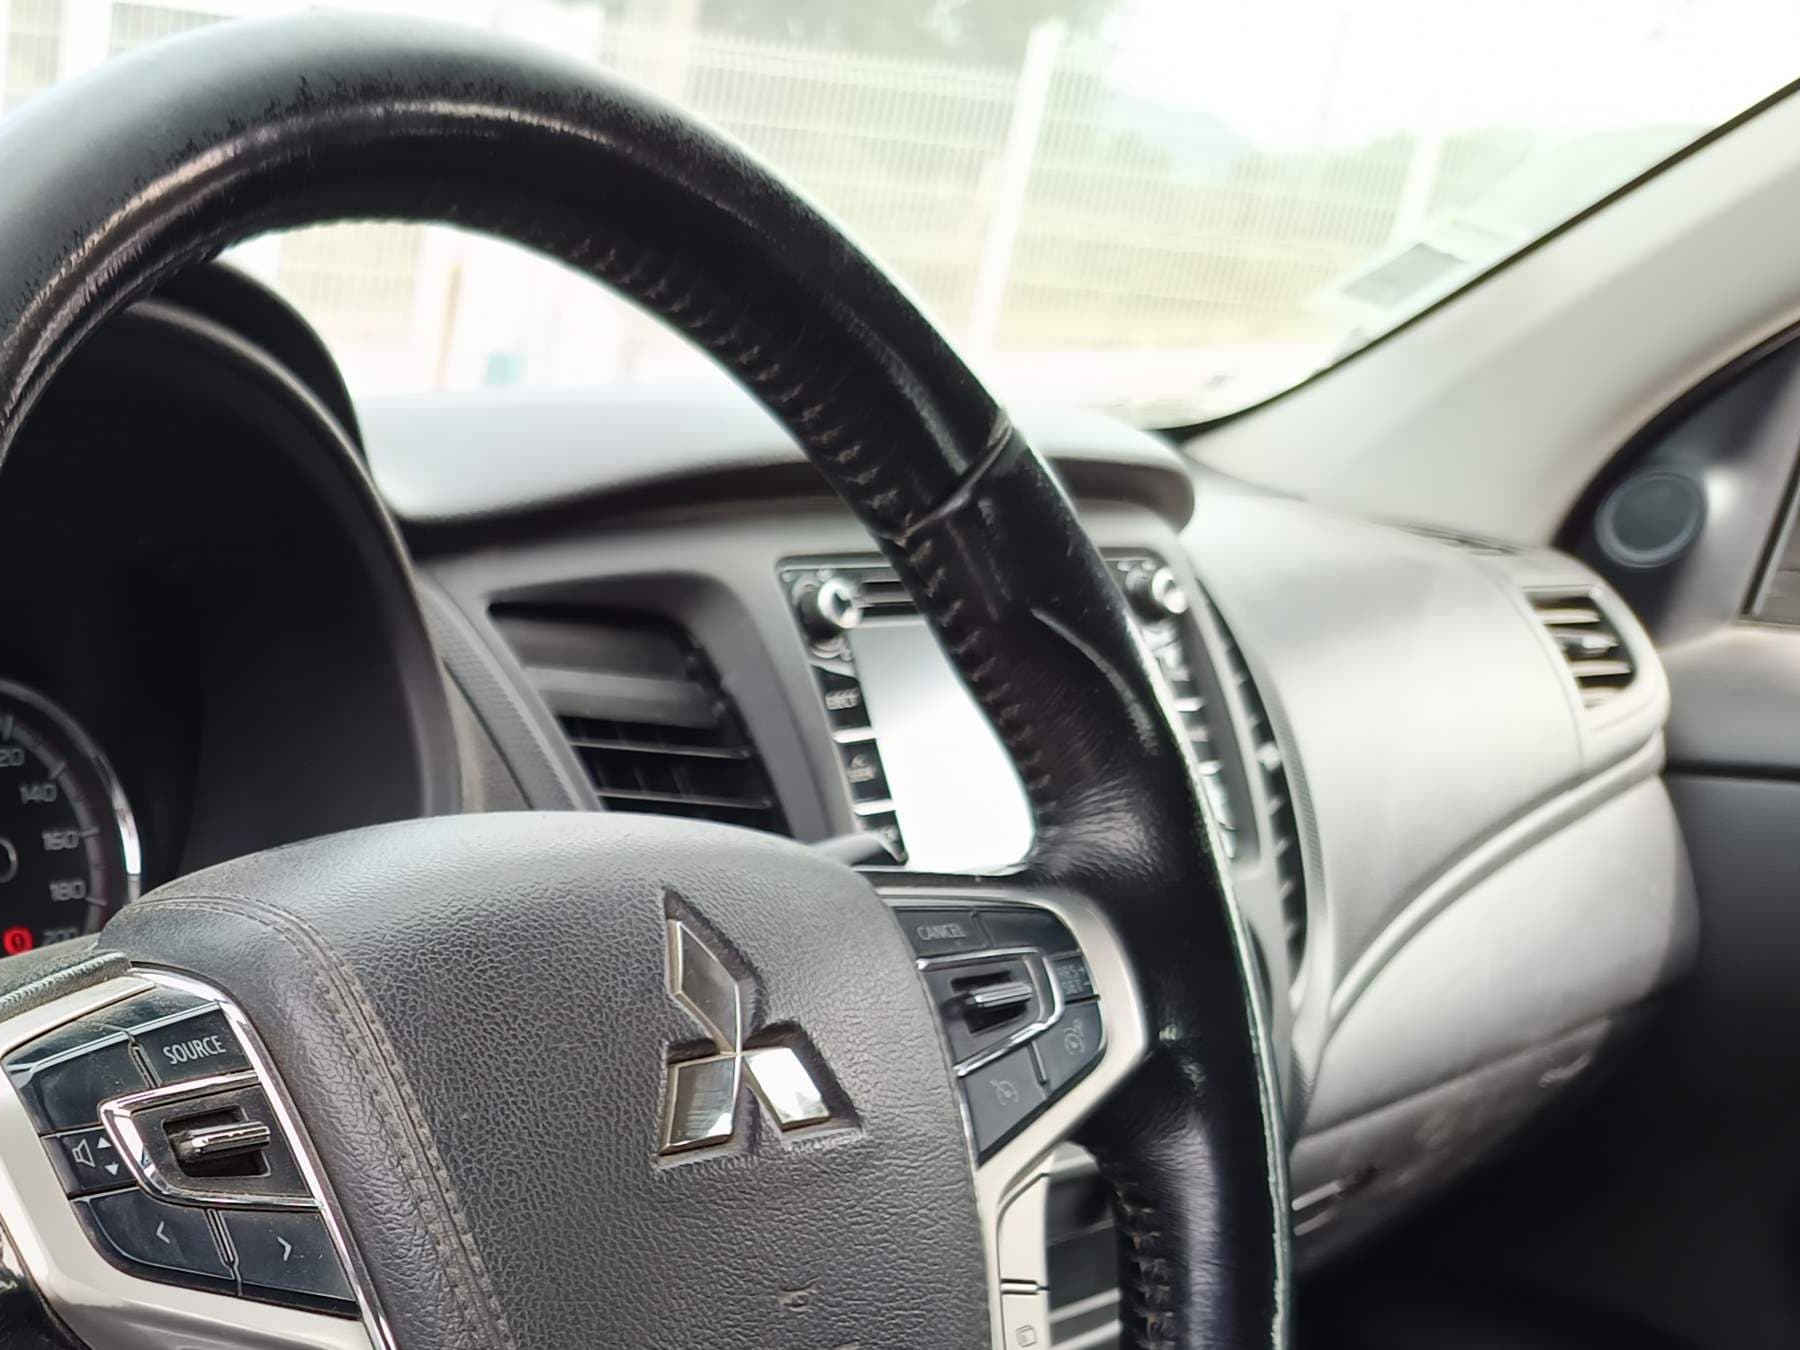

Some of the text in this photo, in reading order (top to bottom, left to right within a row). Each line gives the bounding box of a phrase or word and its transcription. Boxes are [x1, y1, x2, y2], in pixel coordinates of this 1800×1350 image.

[19, 783, 57, 803] 140
[49, 880, 86, 902] 180
[917, 922, 966, 941] CANCEL
[162, 1035, 227, 1065] SOURCE
